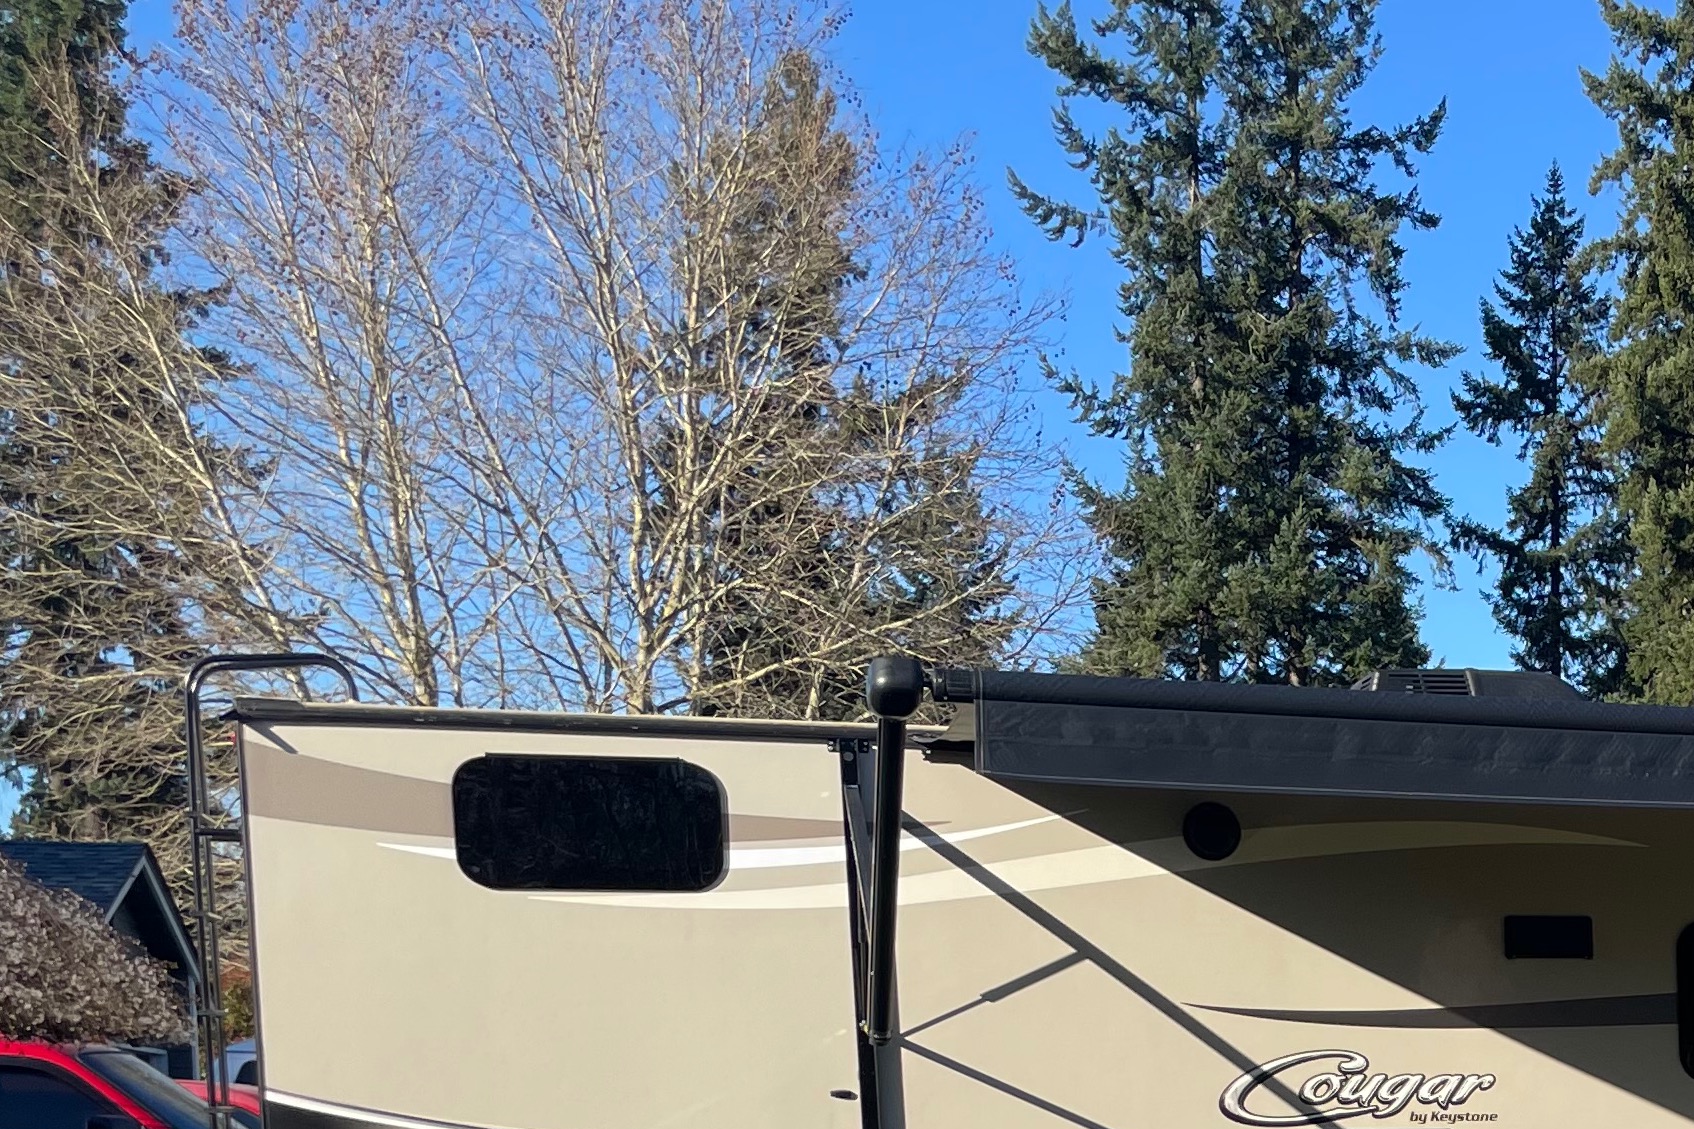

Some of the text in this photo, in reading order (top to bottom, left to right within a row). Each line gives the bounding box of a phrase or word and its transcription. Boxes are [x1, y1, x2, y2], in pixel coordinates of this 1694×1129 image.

[1219, 1050, 1496, 1127] Cougar
[1409, 1111, 1499, 1125] by Keystone
